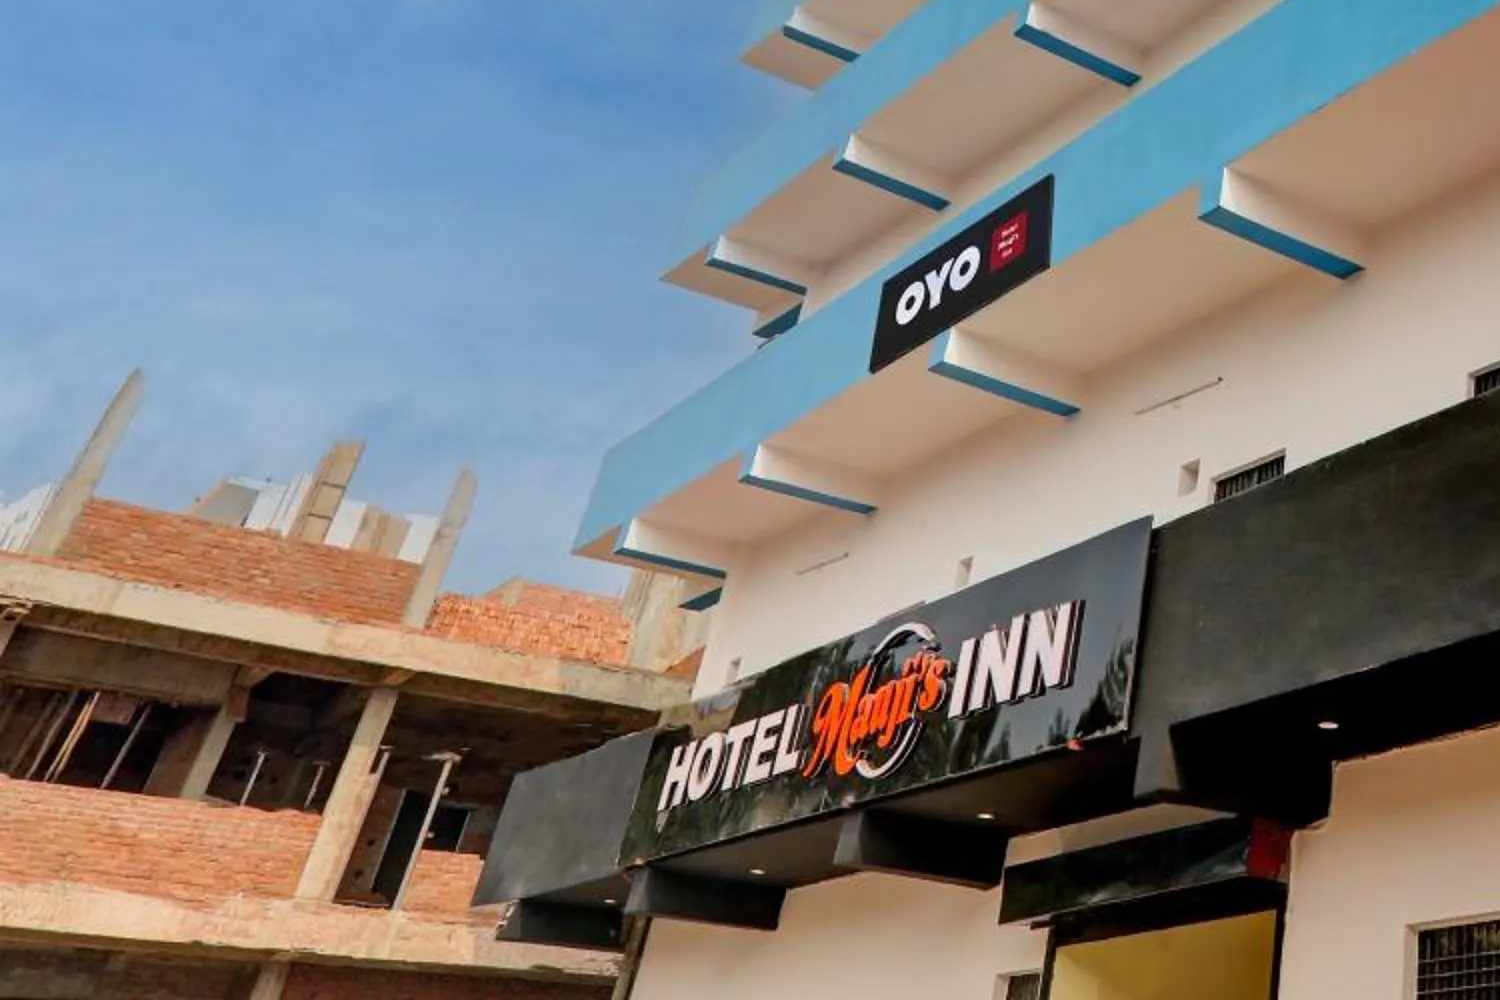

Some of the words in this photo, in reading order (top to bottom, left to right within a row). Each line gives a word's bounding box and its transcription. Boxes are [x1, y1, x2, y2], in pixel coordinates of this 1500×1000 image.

[895, 245, 981, 325] OYO
[657, 702, 802, 812] HOTEL
[948, 600, 1080, 719] INN
